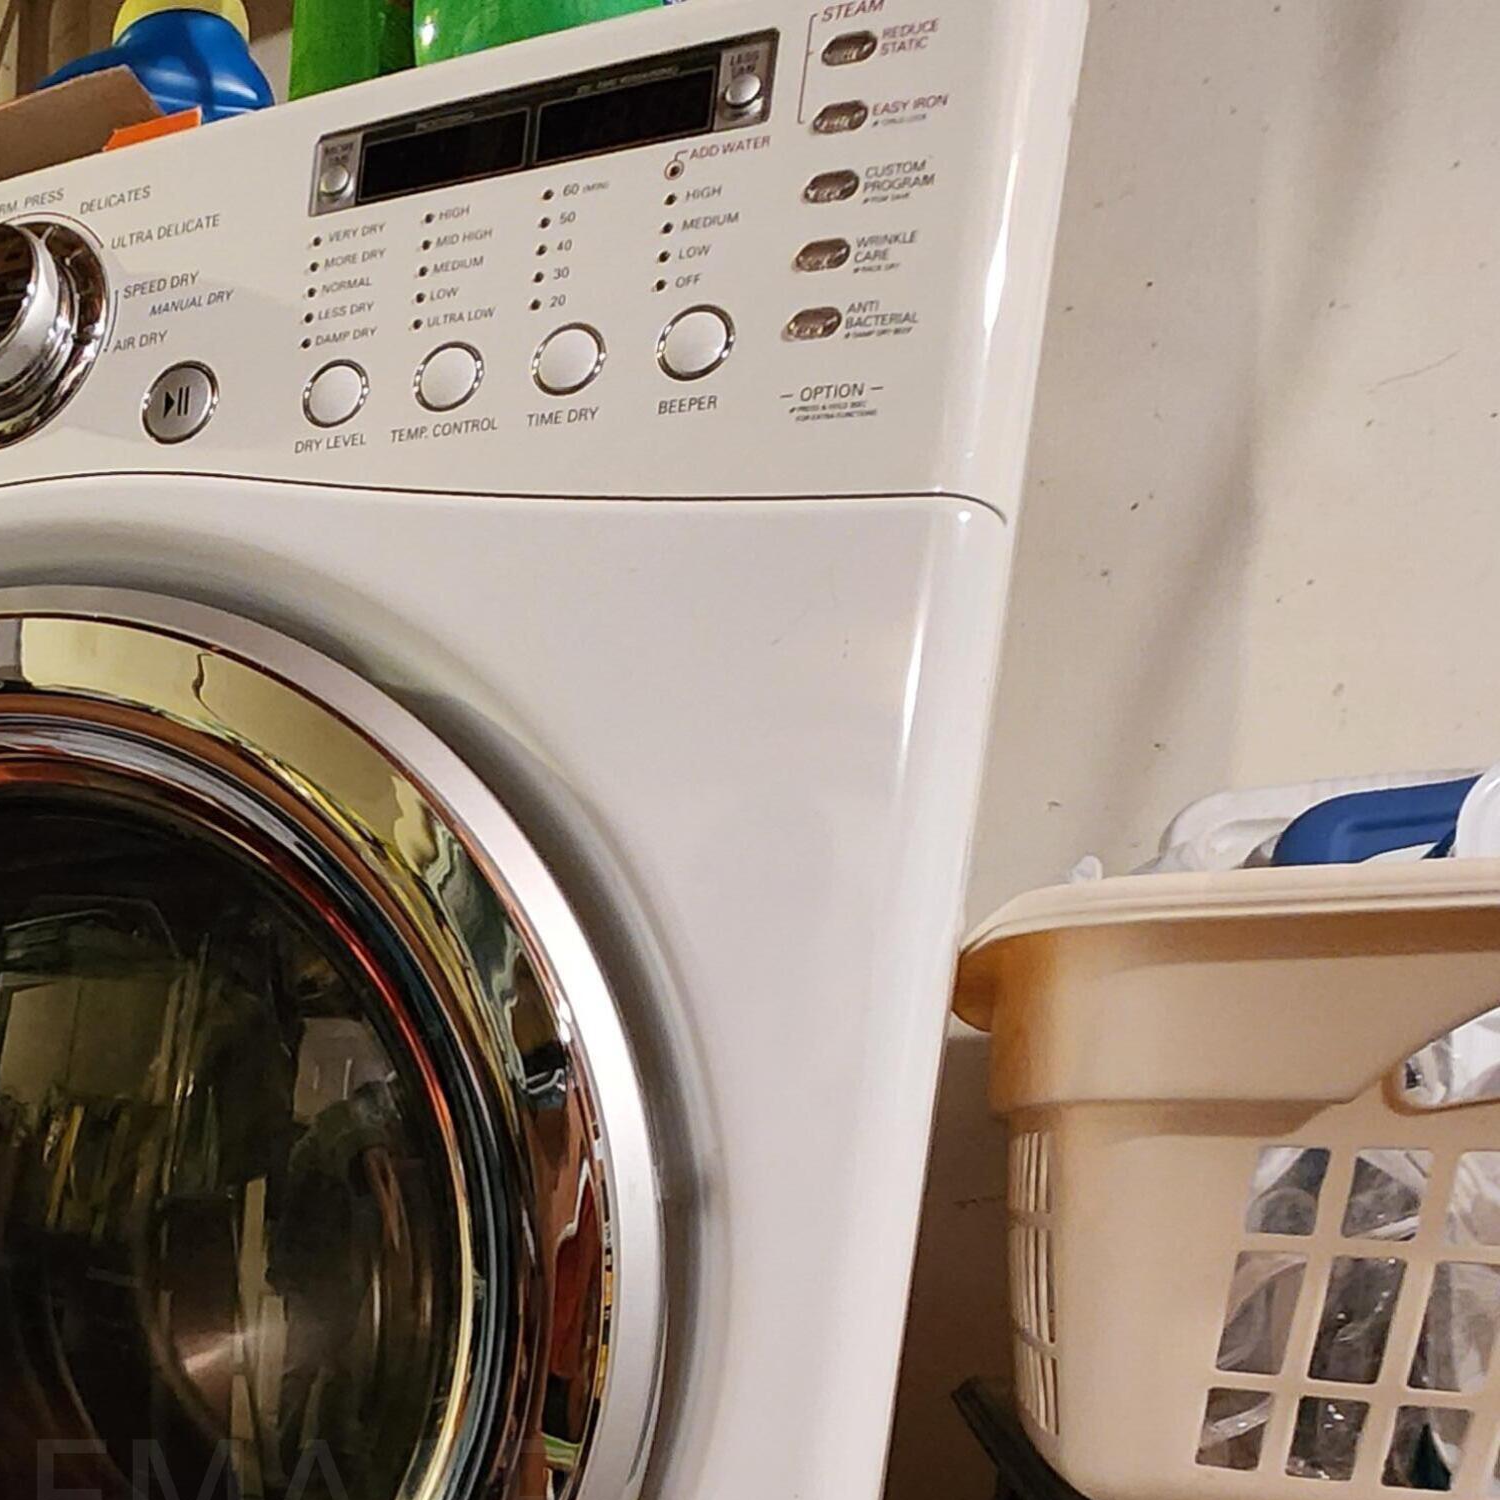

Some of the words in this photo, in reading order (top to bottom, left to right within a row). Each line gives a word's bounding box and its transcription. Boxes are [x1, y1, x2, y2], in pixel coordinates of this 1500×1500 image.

[821, 0, 884, 22] STEAM
[882, 18, 939, 39] REDUCE
[881, 36, 929, 56] STATIC
[872, 100, 910, 116] EASY
[913, 94, 949, 111] IRON
[689, 143, 719, 161] ADD
[722, 135, 772, 153] WATER
[865, 160, 927, 178] CUSTOM
[563, 183, 580, 197] 60
[685, 185, 723, 201] HIGH
[863, 174, 936, 193] PROGRAM
[24, 188, 64, 208] PRESS
[80, 185, 151, 215] DELICATES
[438, 205, 470, 221] HIGH
[559, 212, 576, 225] 50
[681, 211, 740, 232] MEDIUM
[111, 229, 153, 250] ULTRA
[157, 214, 220, 241] DELICATE
[328, 228, 357, 243] VERY
[361, 222, 387, 236] DRY
[436, 233, 459, 248] MID
[461, 228, 493, 243] HIGH
[856, 230, 918, 248] WRINKLE
[556, 239, 573, 252] 40
[678, 244, 711, 260] LOW
[854, 248, 890, 263] CARE
[324, 253, 357, 269] MORE
[361, 248, 387, 263] DRY
[432, 256, 484, 274] MEDIUM
[553, 267, 570, 280] 30
[675, 273, 702, 289] OFF
[123, 278, 167, 299] SPEED
[170, 271, 199, 289] DRY
[321, 277, 372, 294] NORMAL
[430, 287, 460, 301] LOW
[150, 296, 203, 316] MANUAL
[206, 289, 234, 305] DRY
[318, 305, 347, 321] LESS
[350, 301, 375, 315] DRY
[549, 295, 566, 308] 20
[846, 300, 880, 315] ANTI
[427, 311, 464, 328] ULTRA
[467, 307, 497, 321] LOW
[845, 312, 918, 330] BACTERIAL
[113, 336, 136, 352] AIR
[139, 330, 168, 348] DRY
[315, 330, 350, 346] DAMP
[352, 326, 378, 341] DRY
[800, 382, 865, 402] OPTION
[658, 395, 718, 415] BEEPER
[527, 410, 563, 427] TIME
[567, 406, 600, 424] DRY
[390, 427, 429, 443] TEMP.
[432, 417, 498, 438] CONTROL
[294, 438, 322, 454] DRY
[326, 433, 367, 450] LEVEL
